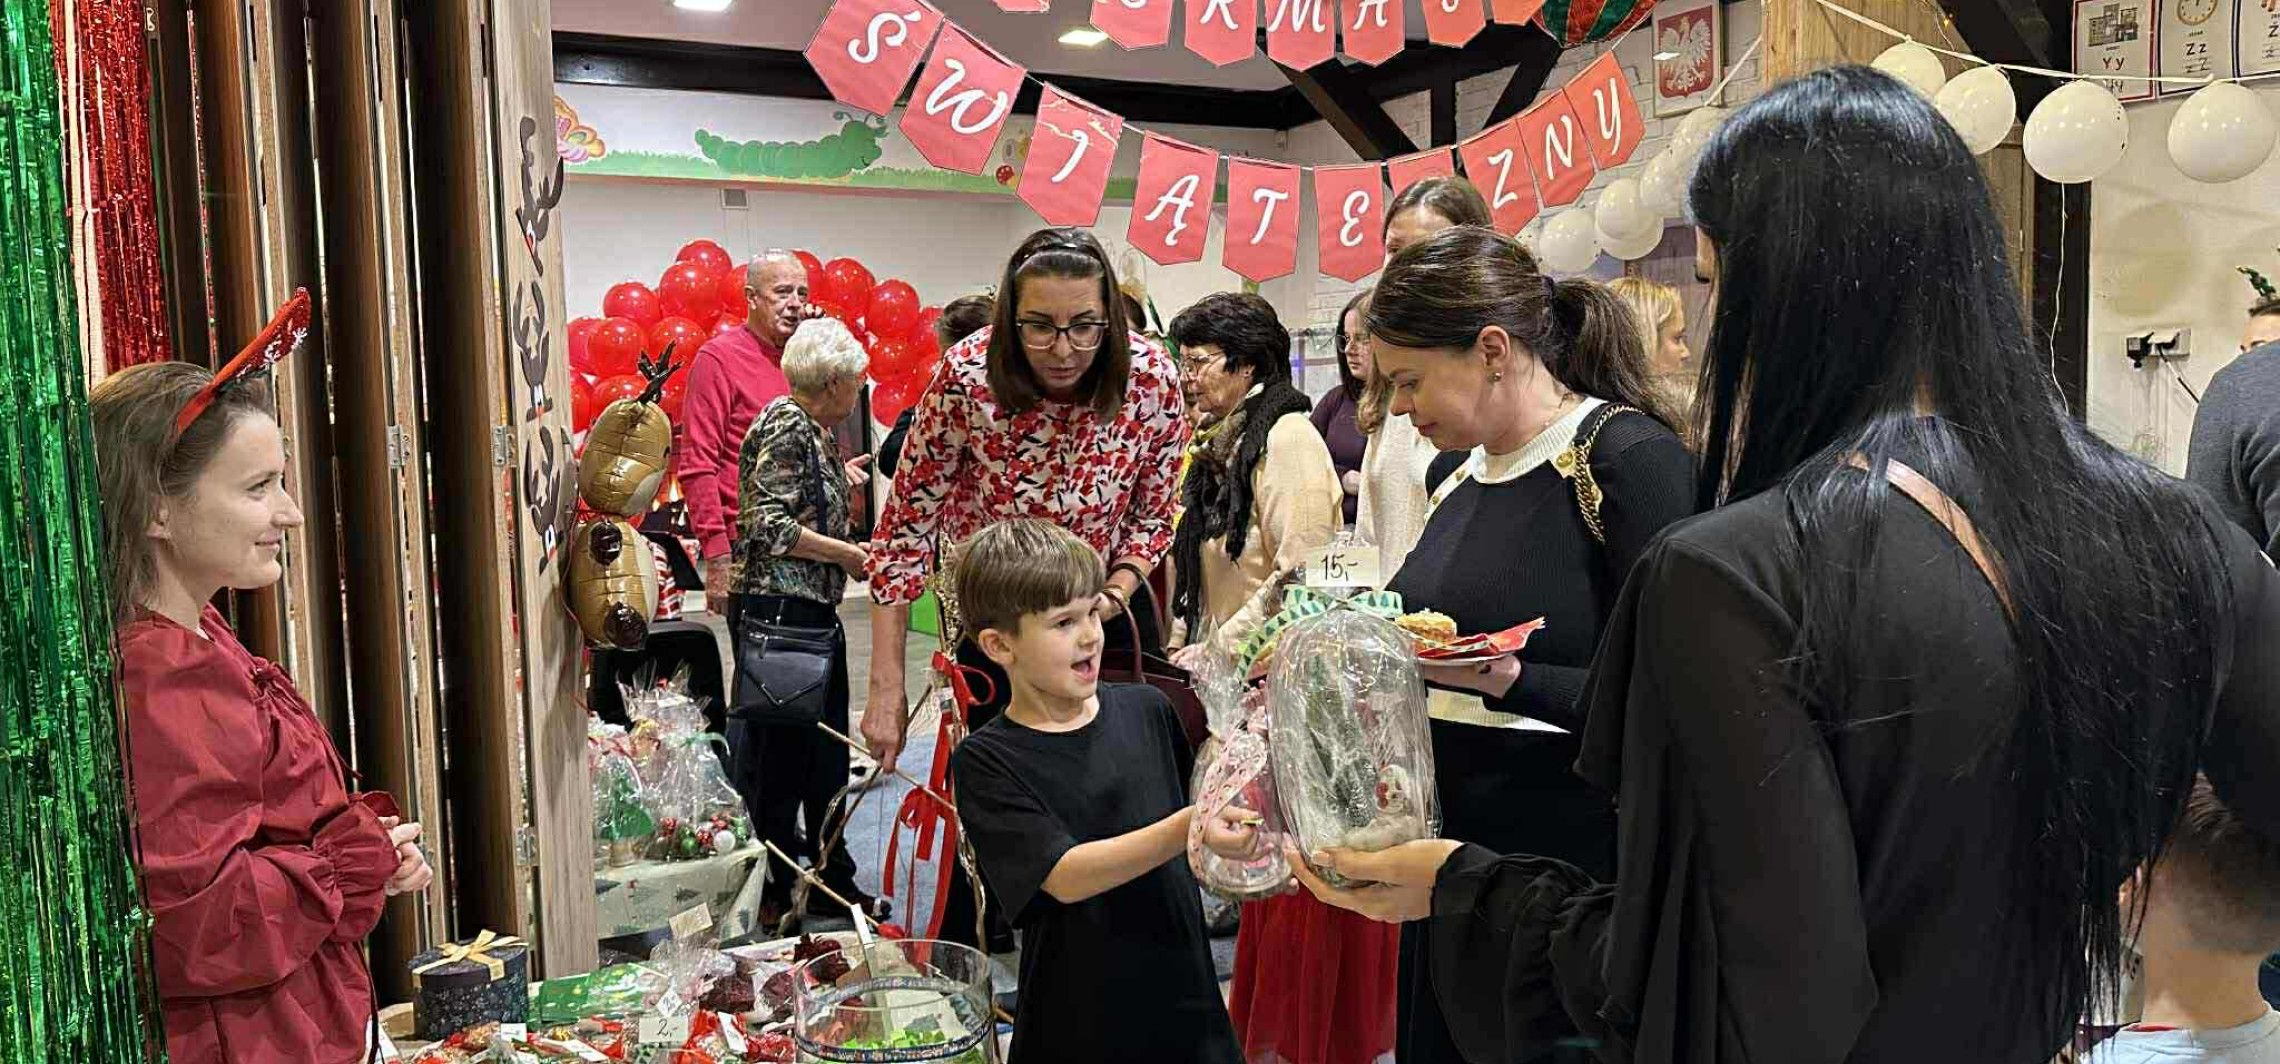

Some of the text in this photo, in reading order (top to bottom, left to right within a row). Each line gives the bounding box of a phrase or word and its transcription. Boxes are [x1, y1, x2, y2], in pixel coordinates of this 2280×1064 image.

[848, 10, 1622, 246] ŚWIĄTEZNY
[1320, 553, 1359, 582] 15,-
[656, 1018, 678, 1038] 2,-
